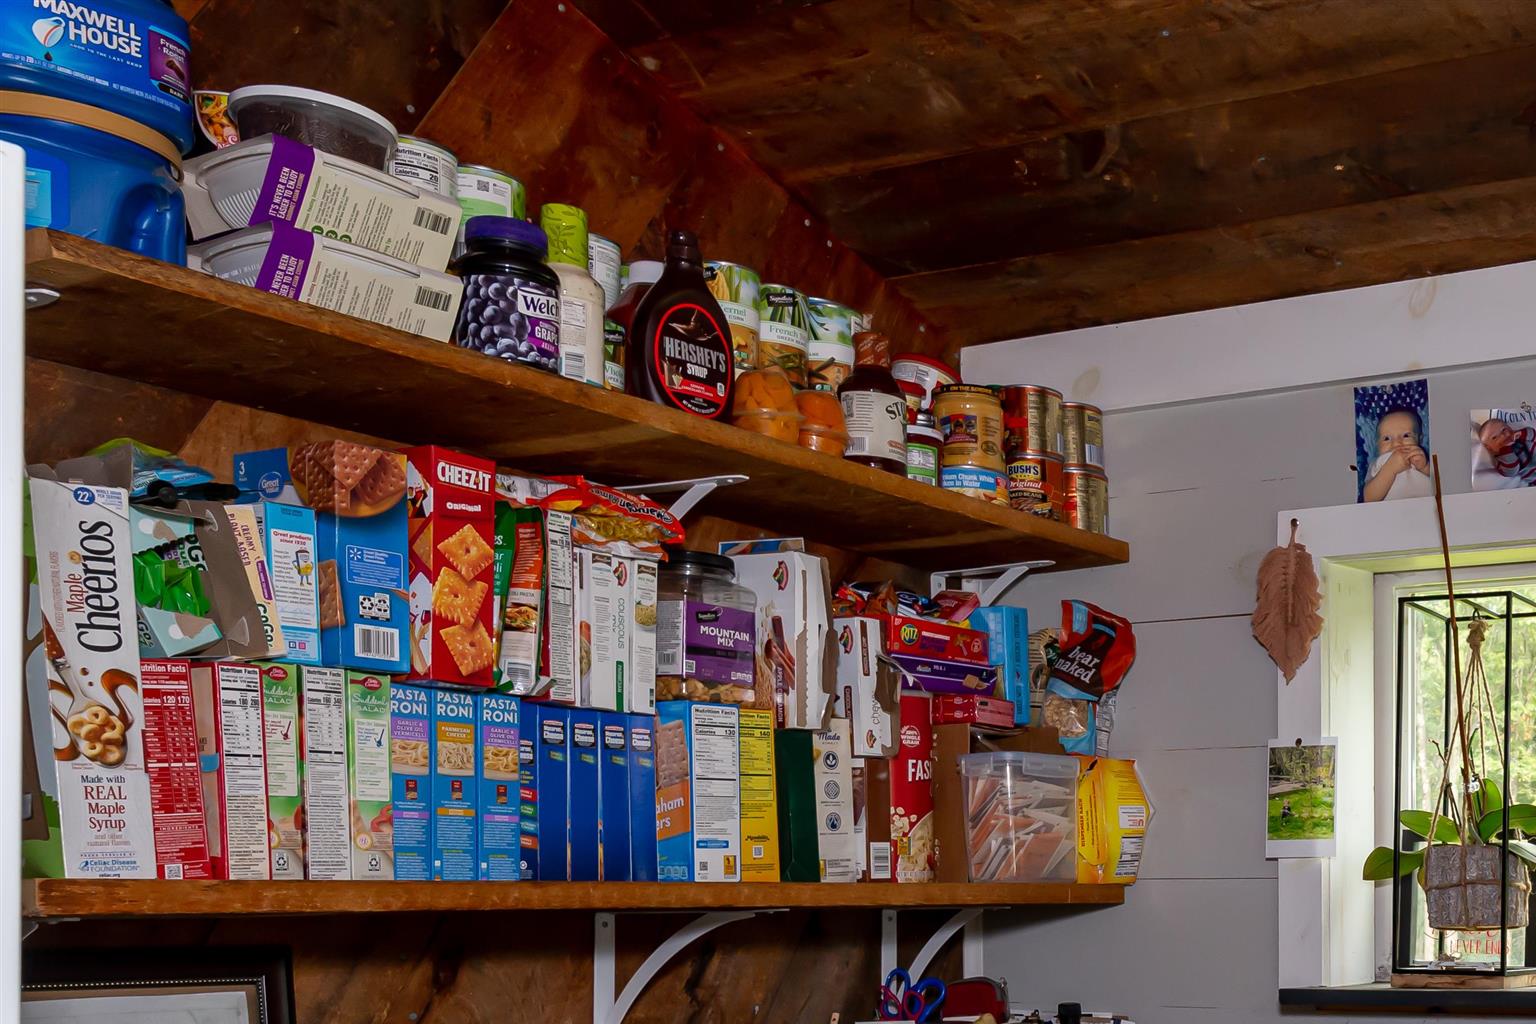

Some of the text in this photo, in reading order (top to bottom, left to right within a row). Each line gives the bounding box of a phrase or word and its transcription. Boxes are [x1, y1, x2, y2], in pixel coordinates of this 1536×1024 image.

[69, 20, 143, 58] HOUSE
[160, 38, 186, 57] French
[423, 152, 439, 161] Facts
[279, 166, 291, 183] BEEN
[395, 167, 420, 177] Calories
[273, 183, 286, 204] NEVER
[277, 199, 291, 220] EASIER
[286, 170, 299, 189] ENJOY
[278, 254, 290, 270] BEEN
[285, 256, 298, 275] ENJOY
[724, 304, 746, 316] ernel
[663, 336, 726, 373] HERSHEY'S
[687, 363, 708, 379] SYRUP
[239, 461, 245, 475] 3
[1008, 464, 1039, 476] BUSH'S
[963, 480, 981, 488] Water
[63, 573, 88, 614] Maple
[75, 520, 123, 653] Cheerios
[617, 598, 625, 649] COUSCOUS
[700, 625, 750, 641] MOUNTAIN
[901, 626, 919, 641] RITZ
[717, 637, 734, 647] MIX
[1068, 645, 1100, 668] bear
[141, 664, 187, 673] utrition Facts
[1055, 659, 1096, 684] naked
[163, 695, 176, 704] 120
[177, 695, 190, 704] 170
[390, 687, 427, 702] PASTA
[437, 691, 473, 705] PASTA
[390, 700, 427, 716] RONI
[437, 703, 473, 719] RONI
[483, 697, 517, 711] PASTA
[483, 709, 518, 724] RONI
[818, 732, 840, 741] Made
[81, 775, 126, 784] Made with
[83, 785, 127, 800] REAL
[88, 802, 125, 817] Maple
[89, 817, 126, 832] Syrup
